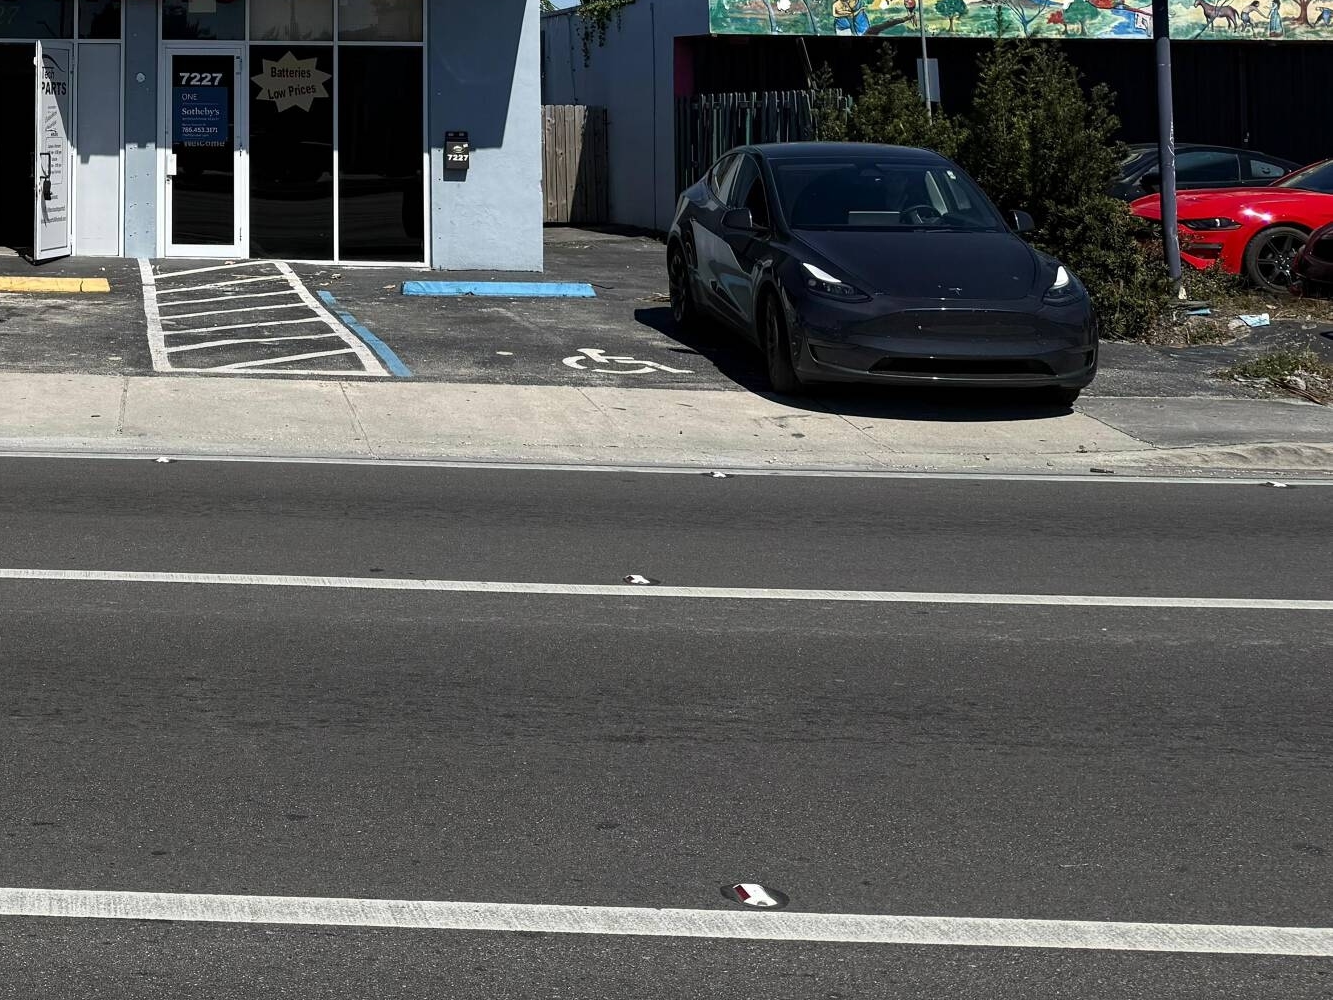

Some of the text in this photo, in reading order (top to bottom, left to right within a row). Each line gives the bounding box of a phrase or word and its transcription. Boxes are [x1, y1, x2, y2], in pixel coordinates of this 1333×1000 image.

[270, 66, 311, 78] Batteries
[179, 72, 223, 85] 7227
[42, 82, 67, 95] PARTS
[268, 84, 316, 100] Low Prices
[181, 93, 199, 101] ONE
[181, 106, 220, 117] Sotheby's
